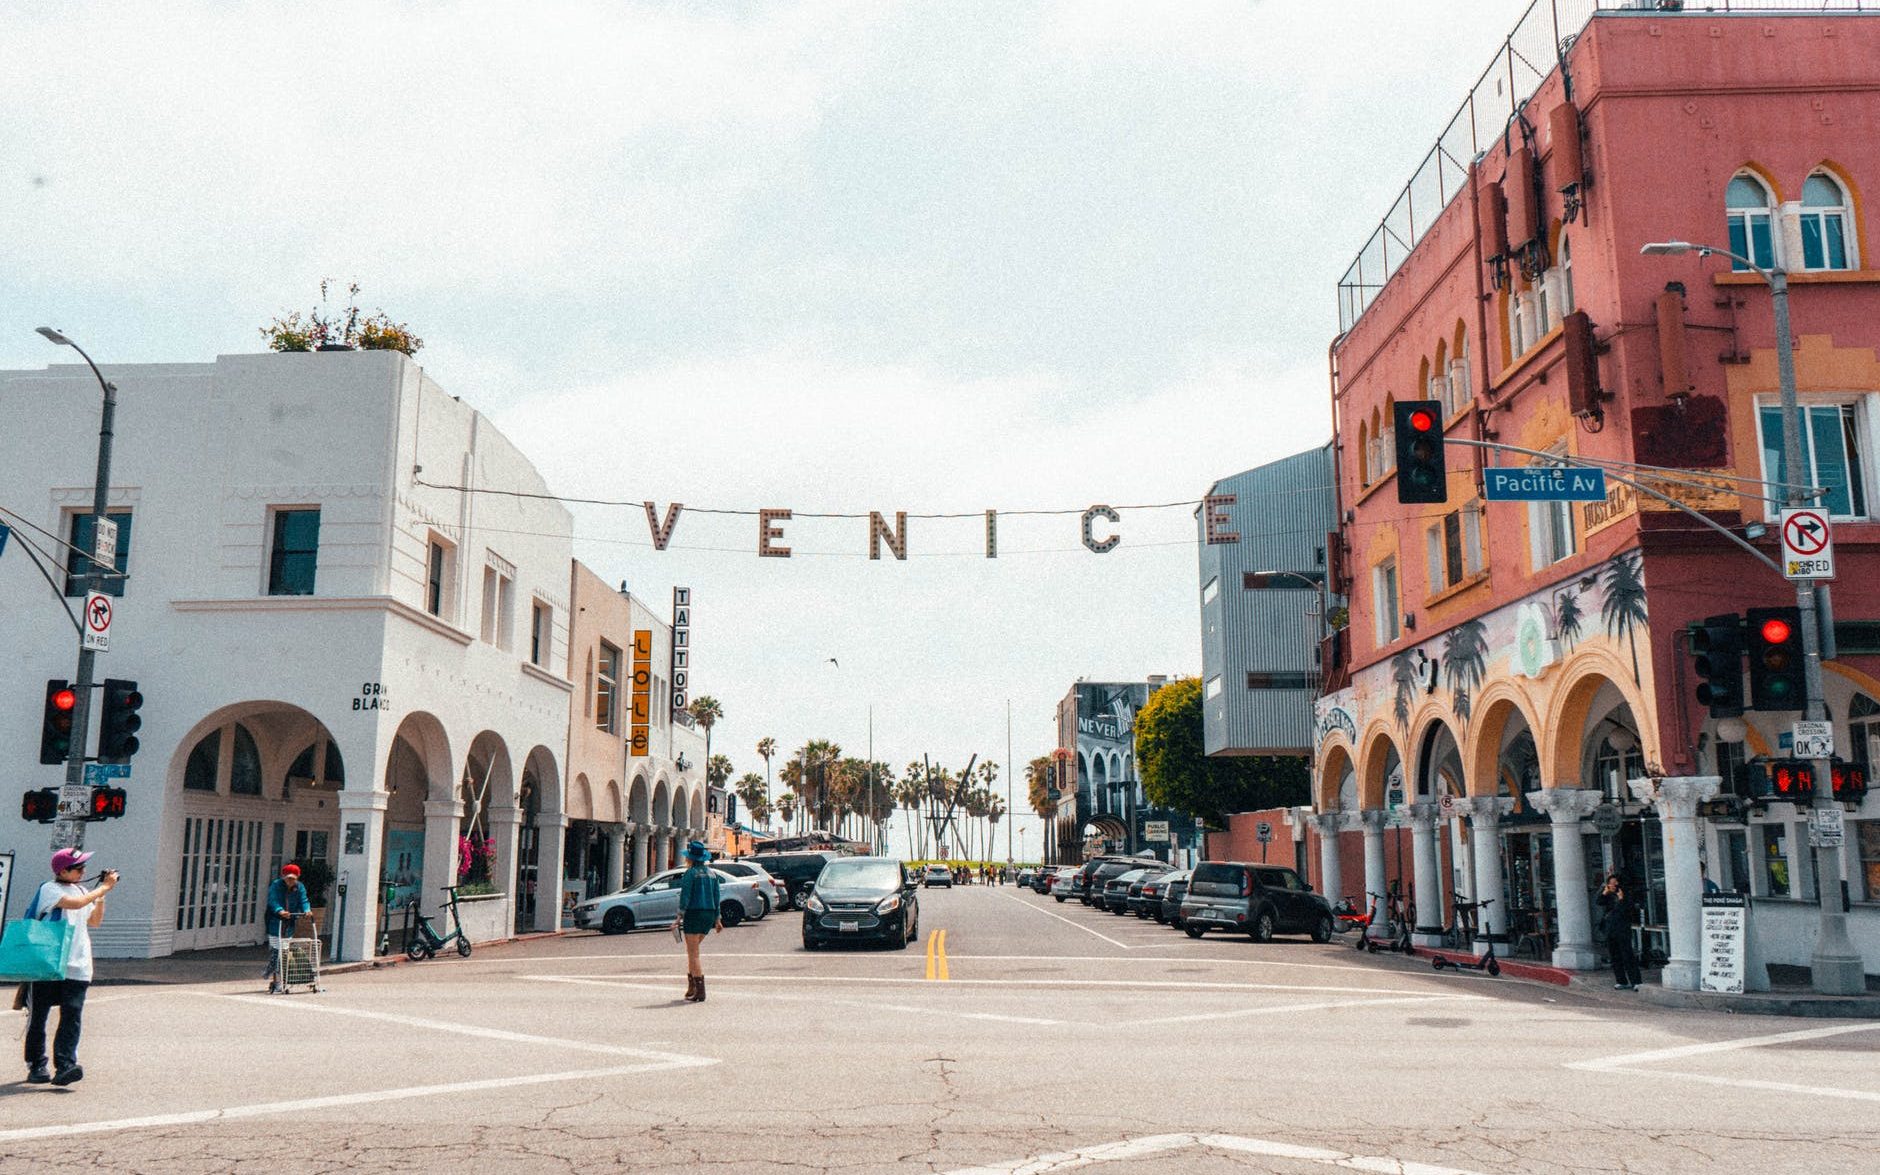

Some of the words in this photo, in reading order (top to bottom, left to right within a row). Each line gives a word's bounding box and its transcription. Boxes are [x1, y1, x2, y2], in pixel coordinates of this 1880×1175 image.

[1495, 475, 1565, 492] Pacific
[1572, 475, 1596, 492] Av
[644, 494, 1240, 560] VENICE
[675, 589, 687, 707] TATTOO
[1078, 717, 1116, 738] NEVER
[1796, 740, 1811, 755] OK
